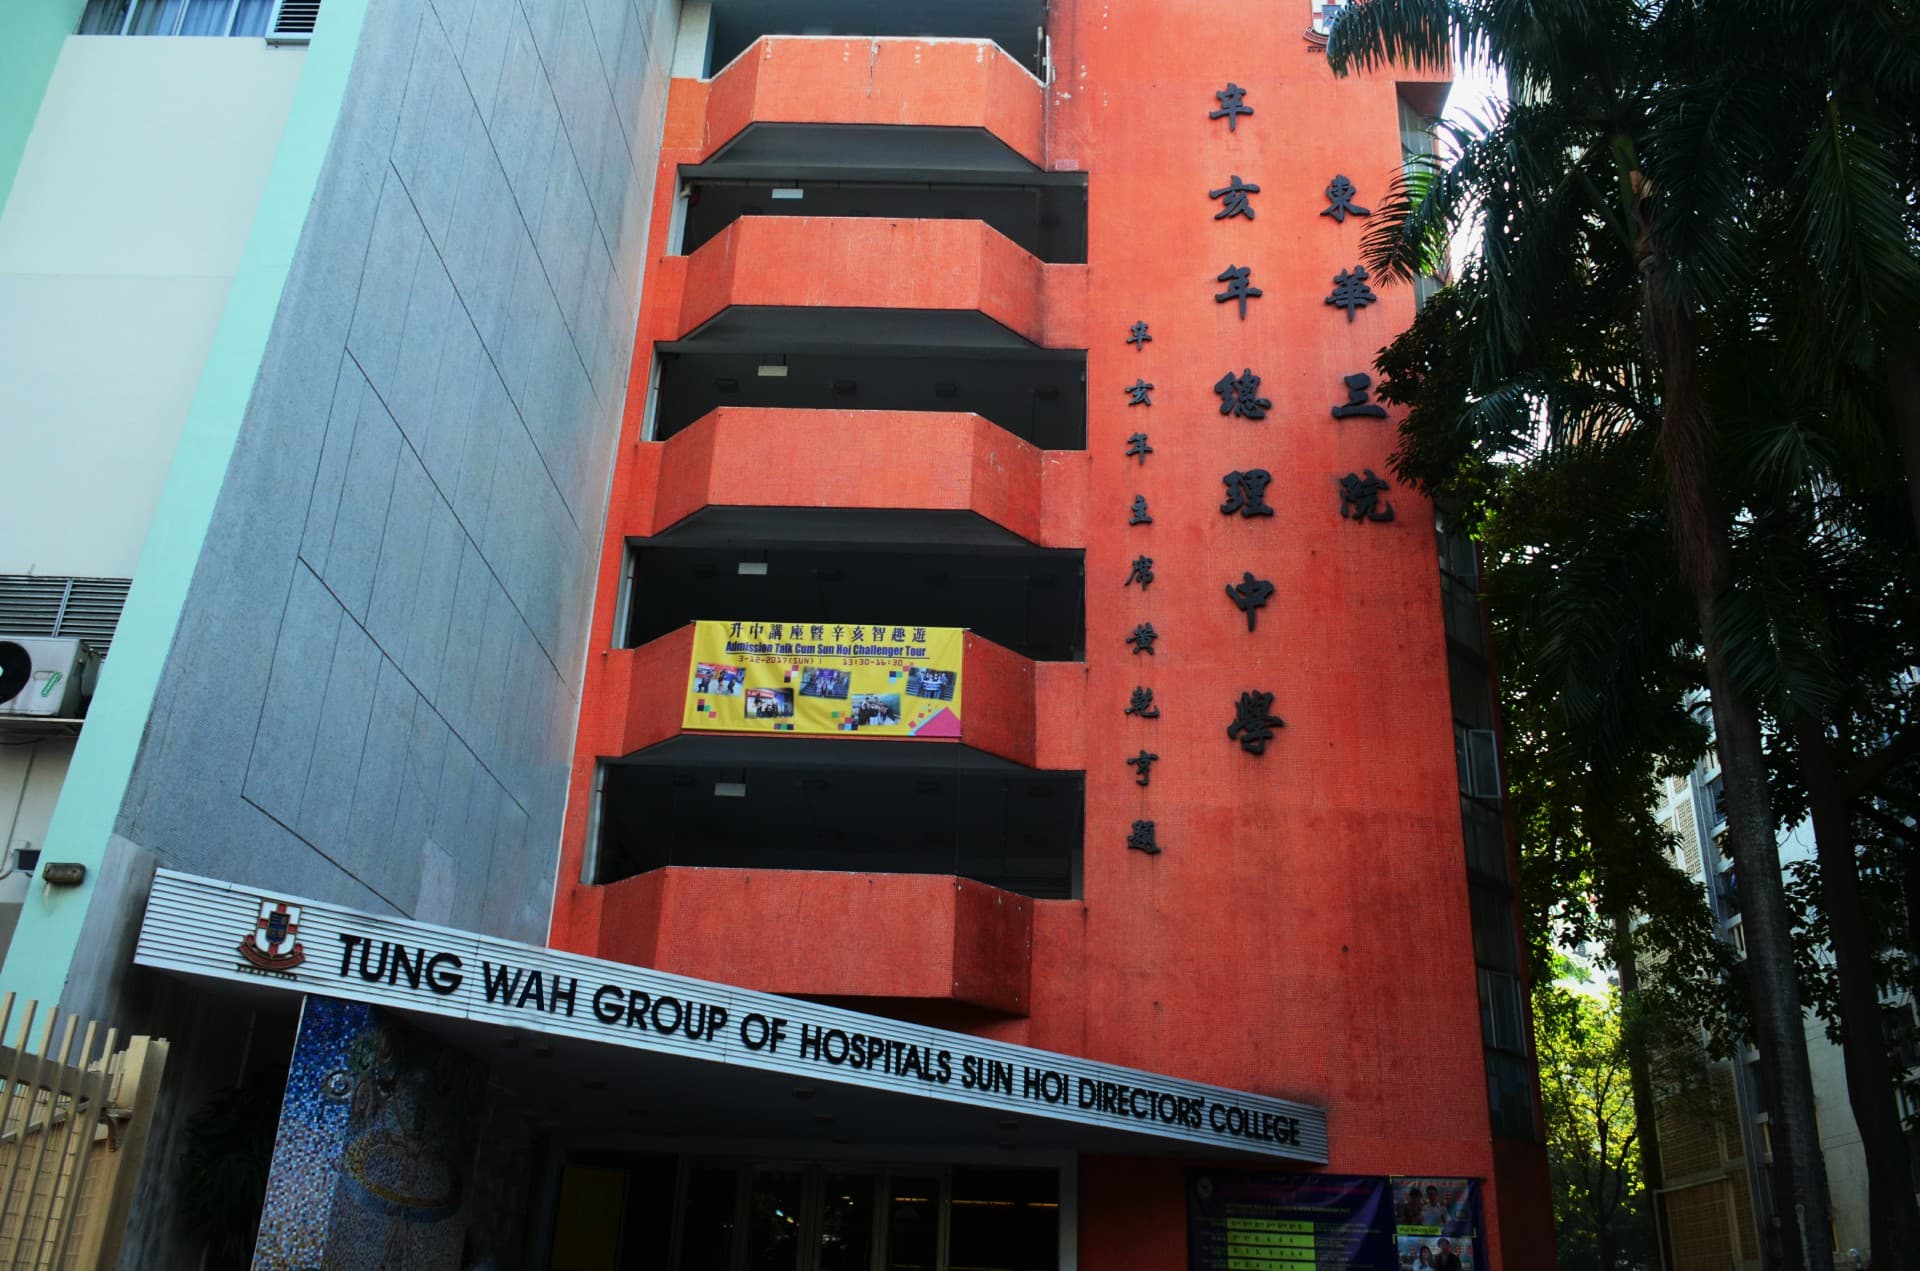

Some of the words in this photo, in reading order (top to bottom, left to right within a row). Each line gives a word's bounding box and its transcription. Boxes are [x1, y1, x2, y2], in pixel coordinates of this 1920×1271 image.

[1209, 82, 1285, 757] 辛亥年總理中學
[1320, 174, 1395, 523] 東華三院
[726, 641, 773, 653] Admission
[775, 643, 793, 654] Talk
[795, 644, 815, 654] Cum
[817, 644, 835, 655] Sun
[836, 645, 851, 656] Hoi
[853, 645, 903, 657] Challenger
[905, 646, 927, 657] Tour
[338, 933, 464, 995] TUNG
[482, 960, 577, 1018] WAH
[593, 984, 729, 1042] GROUP
[740, 1013, 788, 1053] OF
[801, 1023, 952, 1085] HOSPITALS
[961, 1055, 1014, 1096] SUN
[1023, 1066, 1070, 1106] HOI
[1208, 1103, 1301, 1147] COLLEGE
